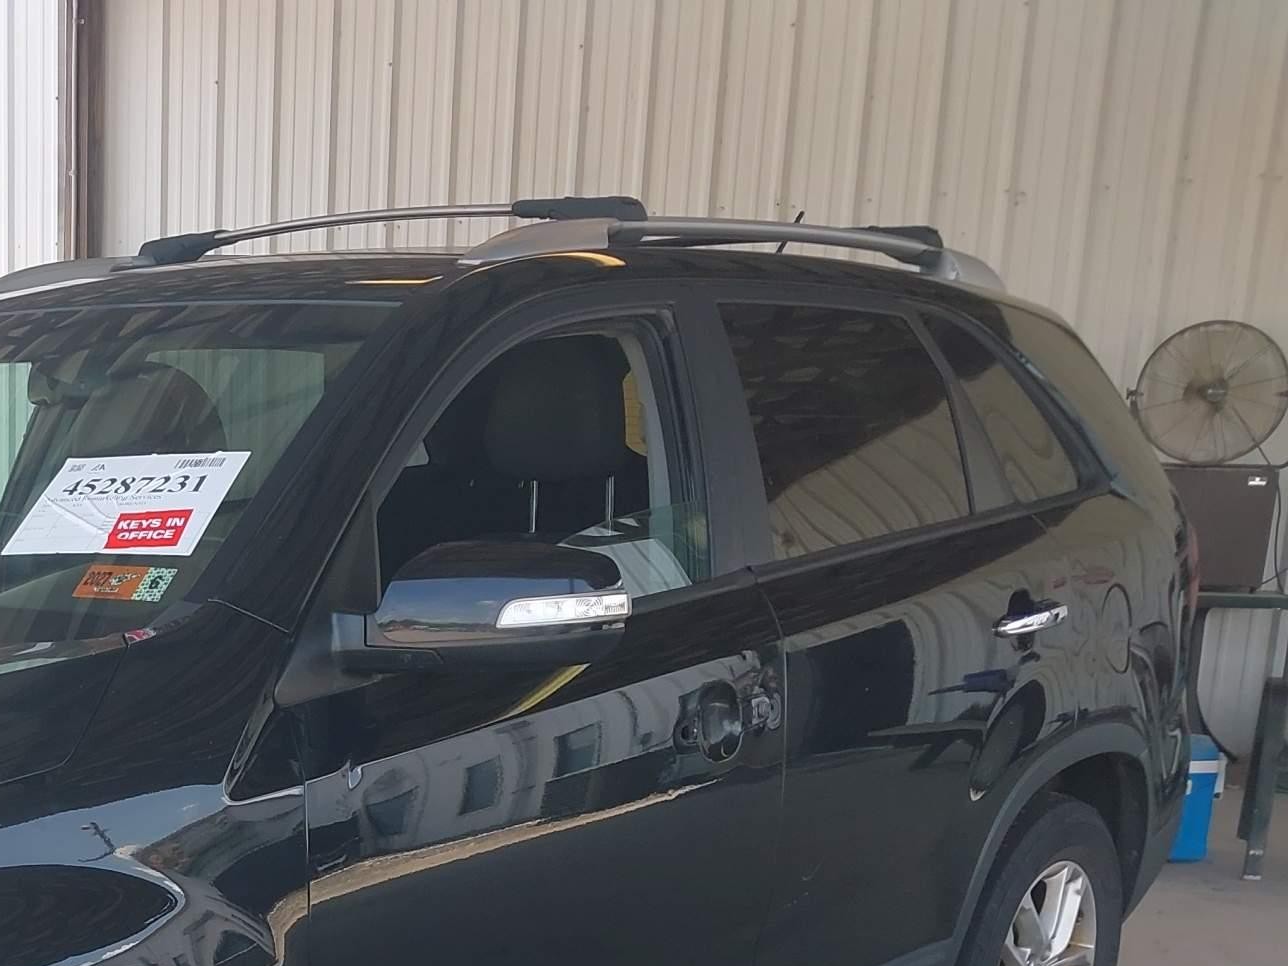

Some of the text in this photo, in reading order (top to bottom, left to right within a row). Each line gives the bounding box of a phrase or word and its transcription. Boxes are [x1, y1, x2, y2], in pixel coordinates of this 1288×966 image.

[62, 474, 209, 496] 45287231
[117, 517, 186, 530] KEYS IN
[117, 529, 176, 540] OFFICE
